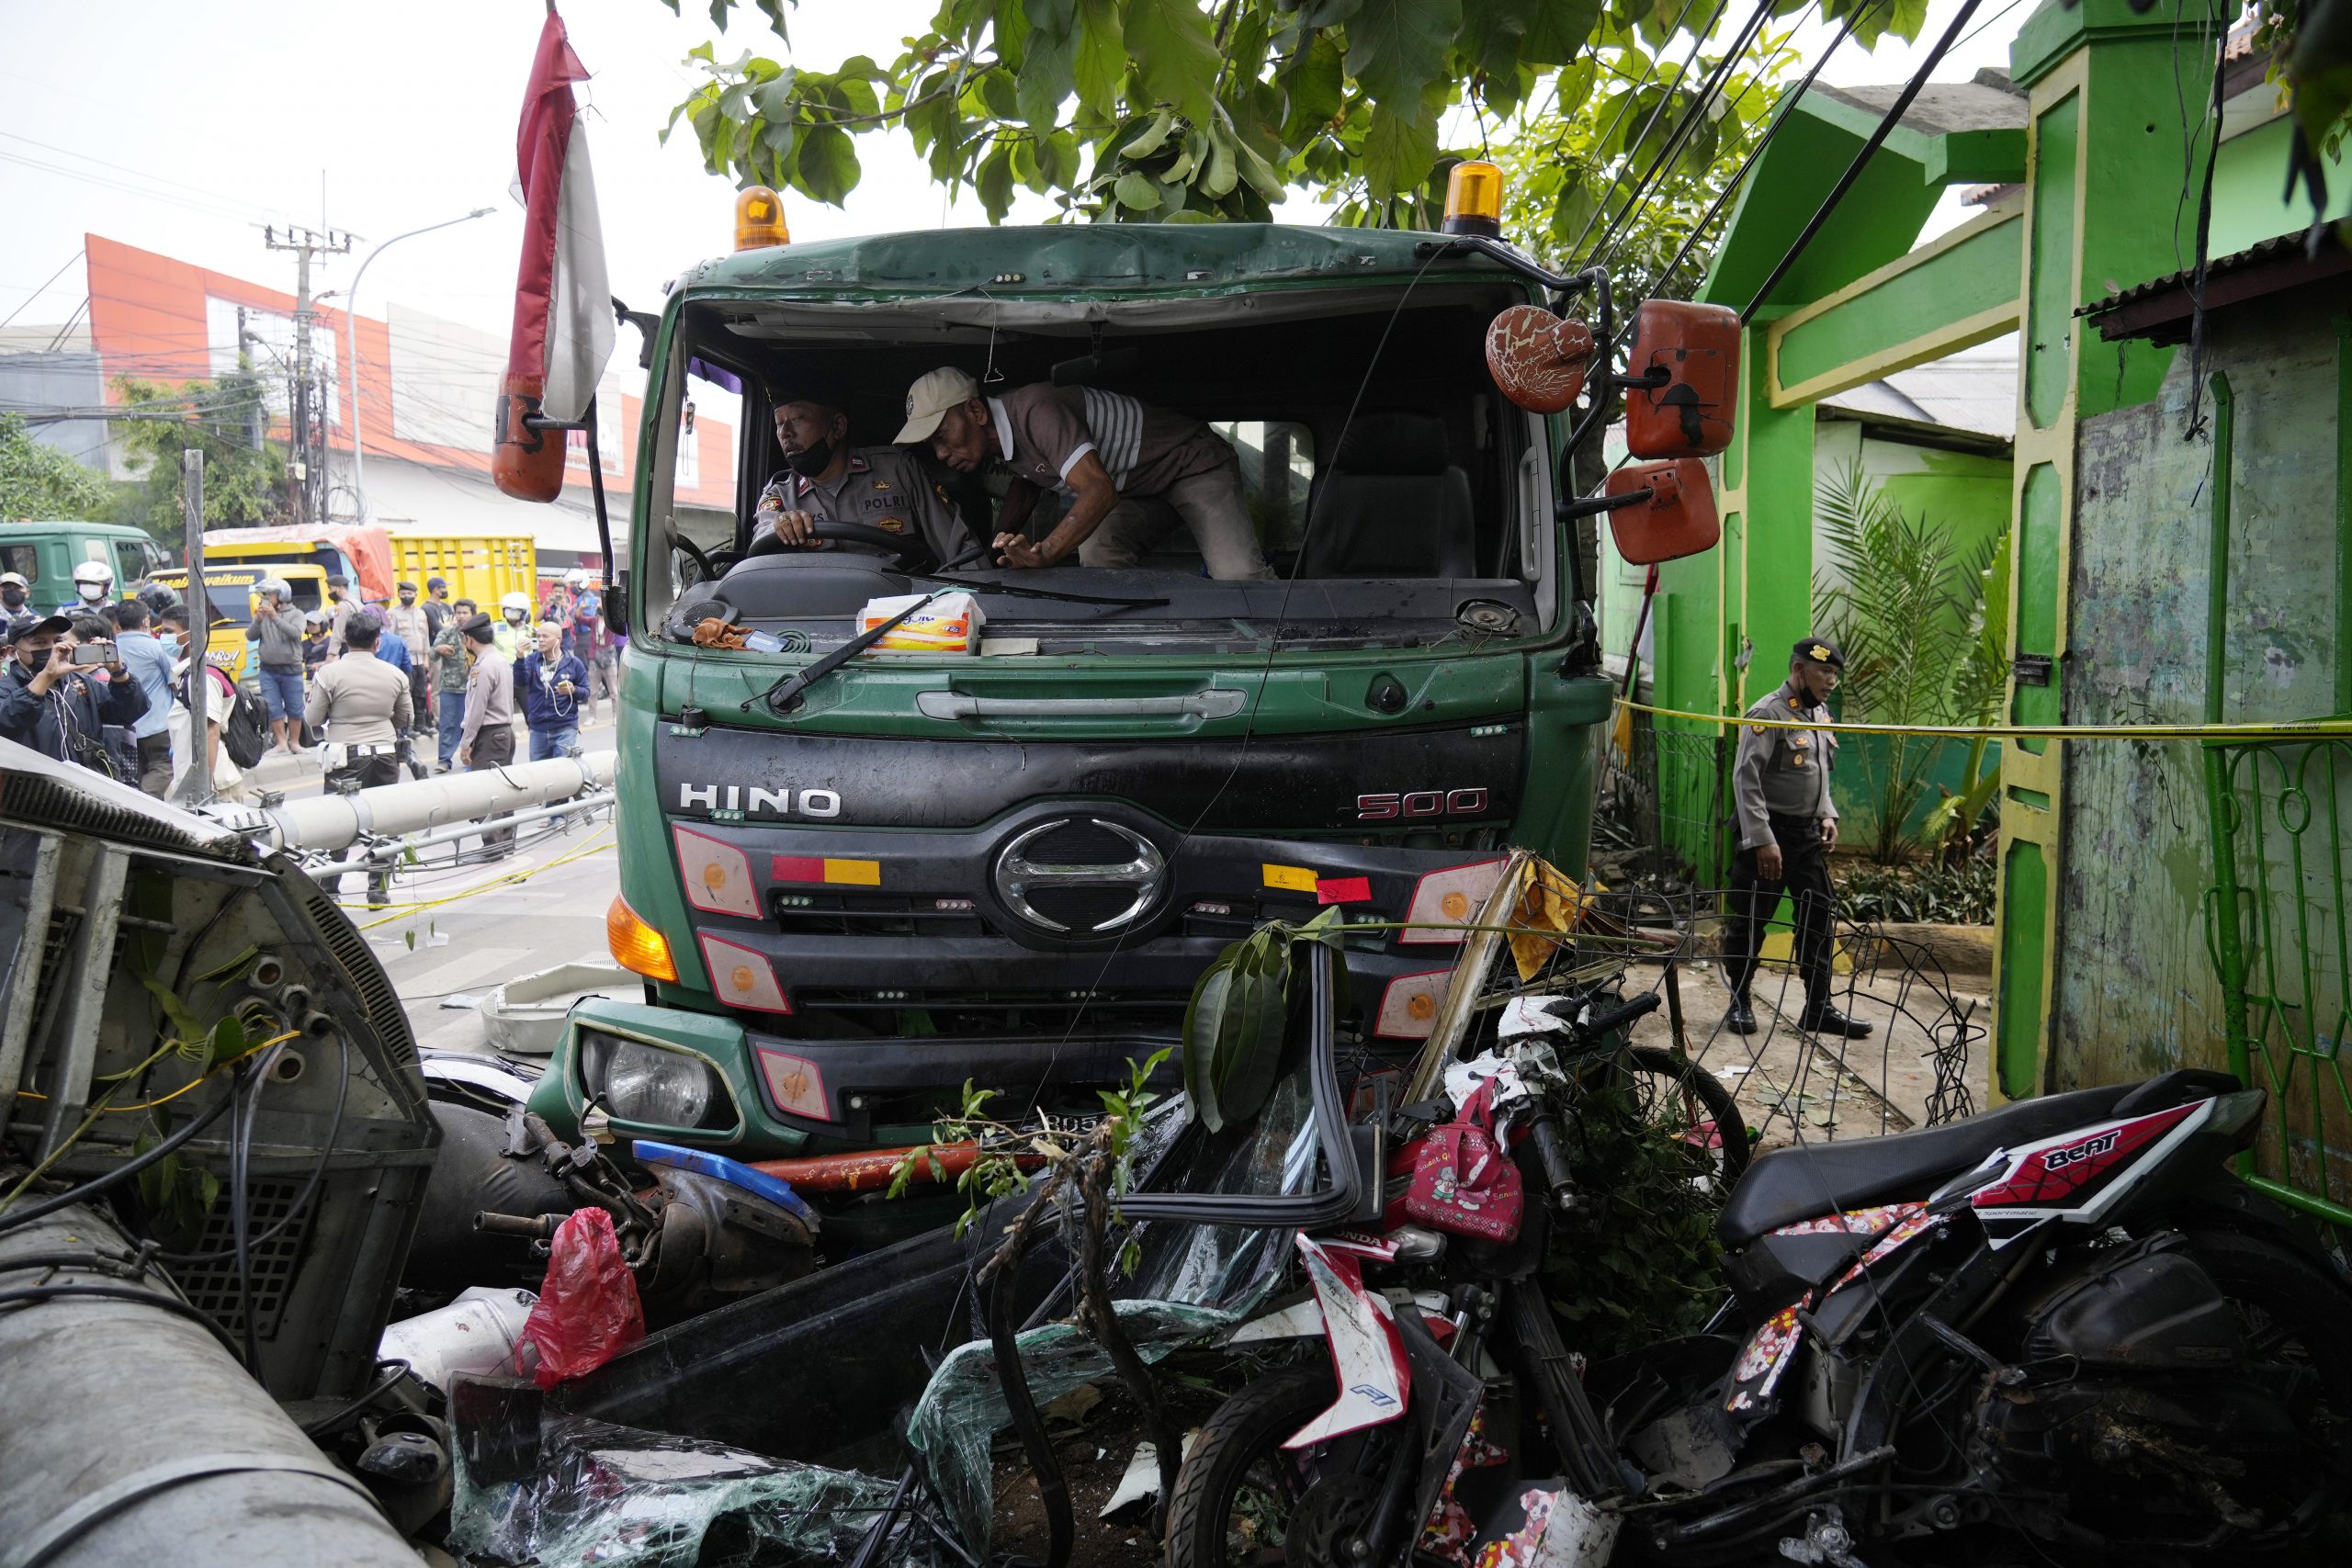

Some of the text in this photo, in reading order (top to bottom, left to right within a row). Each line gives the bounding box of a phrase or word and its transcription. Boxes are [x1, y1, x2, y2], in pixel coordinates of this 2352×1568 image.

[865, 496, 905, 511] POLRI
[680, 783, 842, 818] HINO
[1358, 787, 1488, 819] 500
